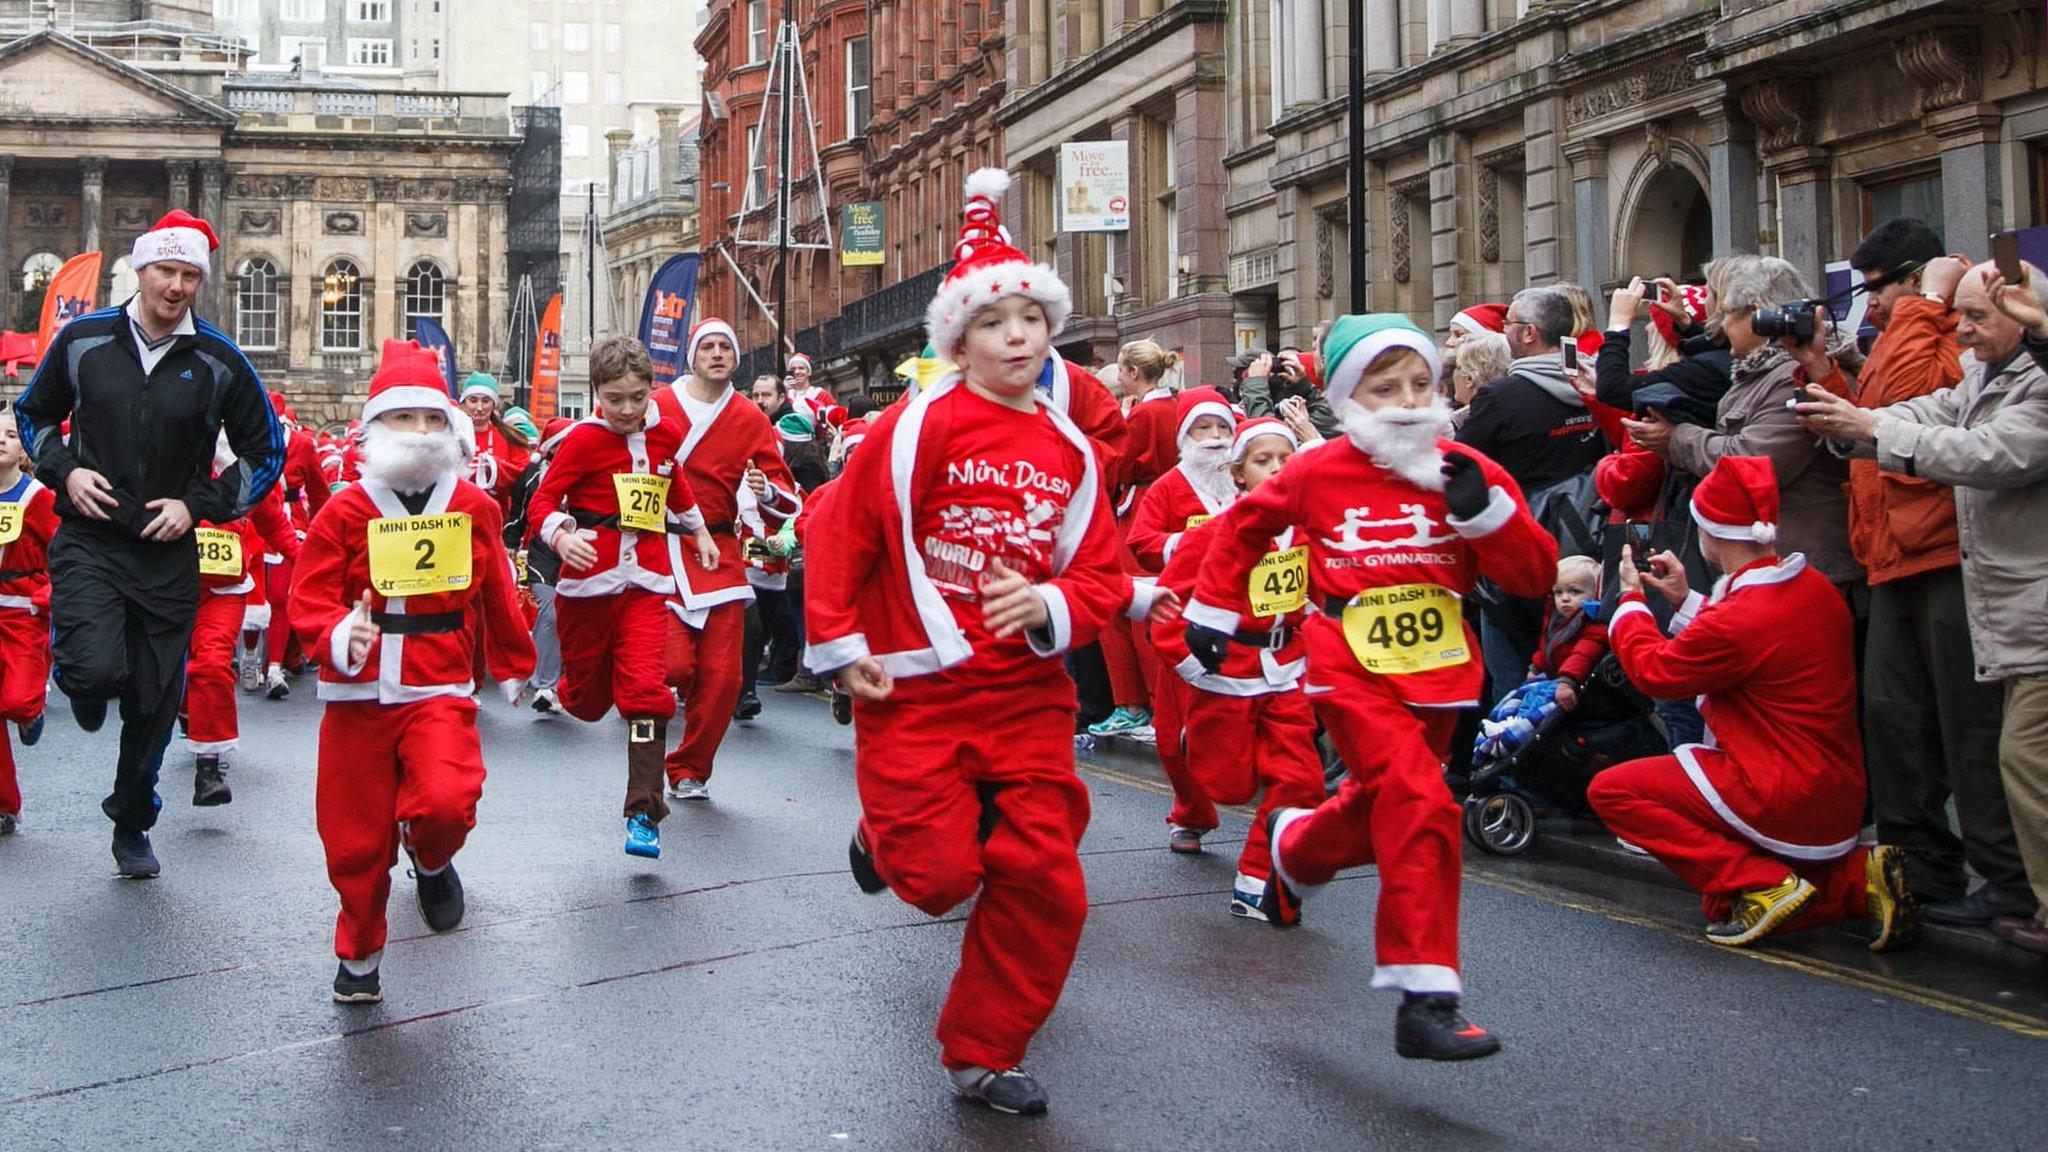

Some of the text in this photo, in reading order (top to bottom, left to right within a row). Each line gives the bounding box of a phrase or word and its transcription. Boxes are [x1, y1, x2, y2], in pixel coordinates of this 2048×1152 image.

[1072, 150, 1105, 161] Move
[848, 204, 871, 213] Move
[948, 458, 1009, 487] Mini
[641, 477, 657, 486] DASH
[630, 489, 660, 515] 276
[0, 516, 12, 533] 5
[379, 517, 461, 533] MINI DASH 1K
[197, 542, 233, 561] 483
[414, 538, 435, 570] 2
[925, 536, 985, 572] WORLD
[1278, 552, 1296, 564] DASH
[1325, 552, 1457, 569] TOTAL GYMNASTICS
[1264, 565, 1304, 595] 420
[1388, 588, 1425, 604] DASH
[1367, 607, 1443, 649] 489
